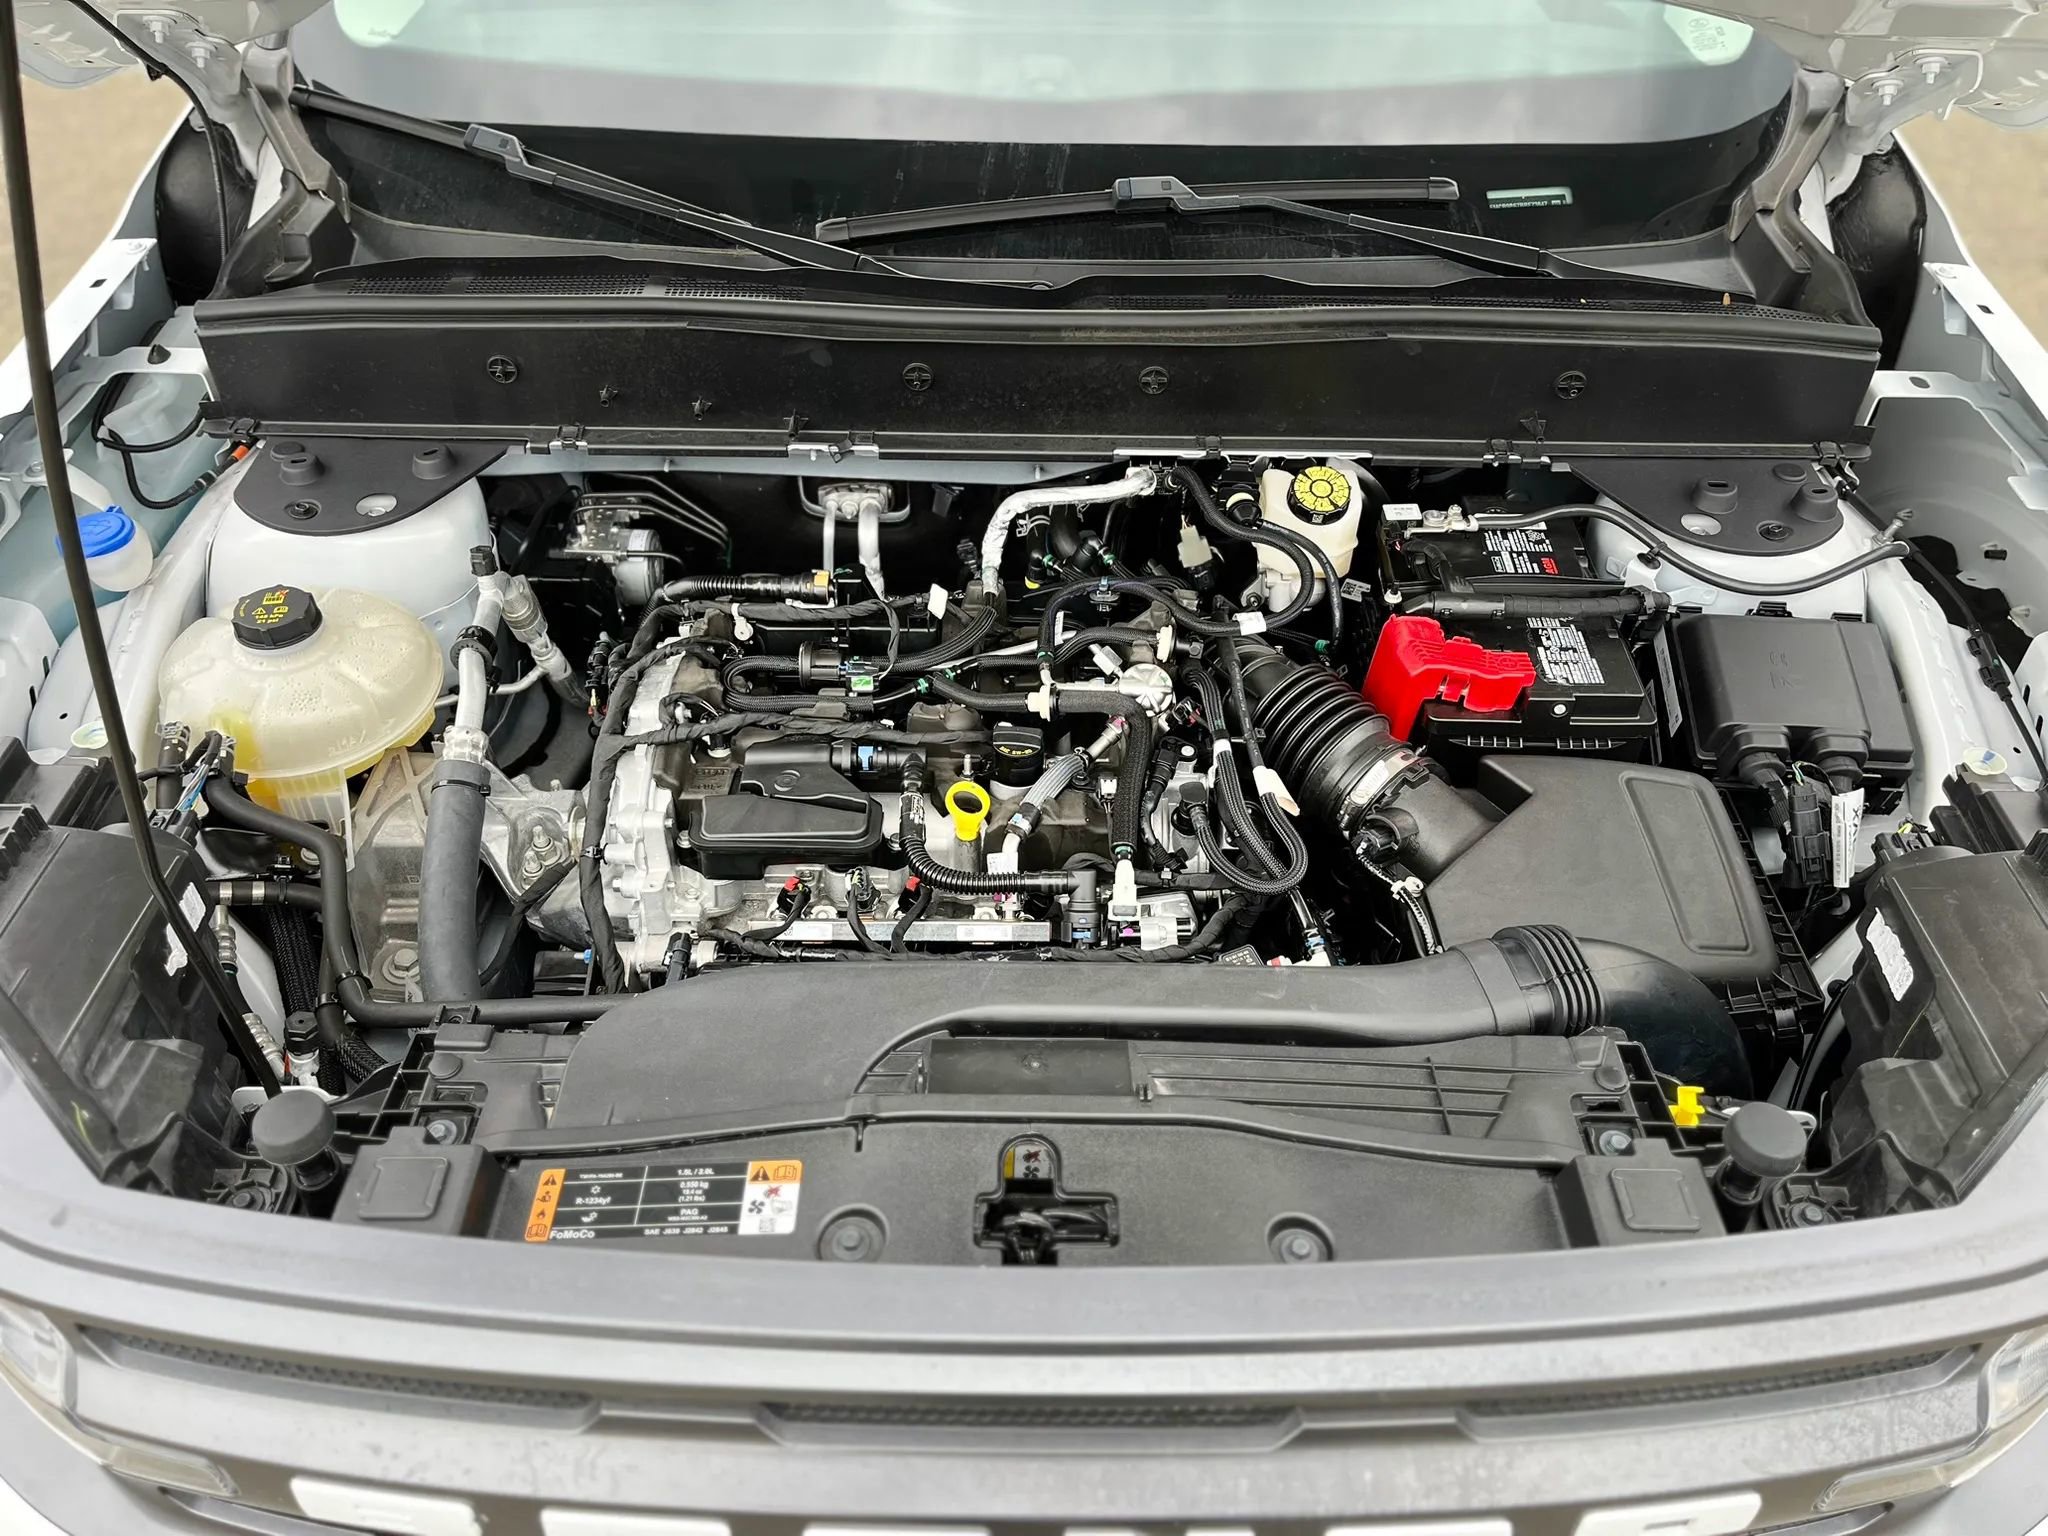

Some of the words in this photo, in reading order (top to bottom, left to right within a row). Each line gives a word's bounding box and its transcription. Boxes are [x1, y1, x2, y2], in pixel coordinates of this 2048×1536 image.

[575, 1196, 612, 1205] R-1234yf
[680, 1208, 699, 1216] PAG
[549, 1229, 595, 1240] FoMoCo
[644, 1228, 660, 1236] SAE
